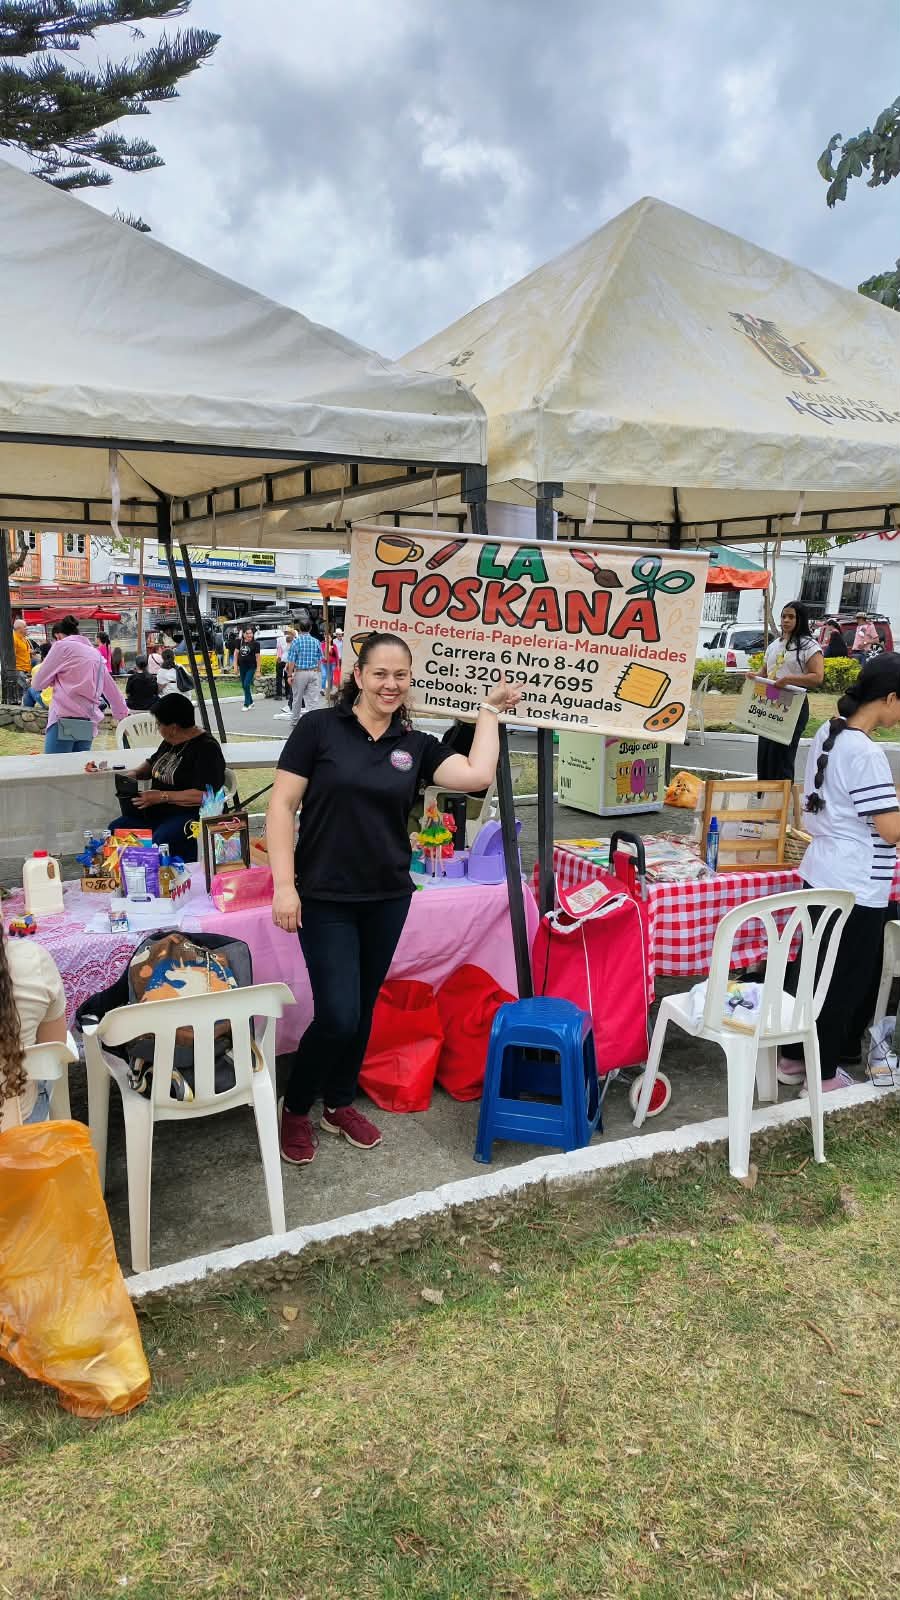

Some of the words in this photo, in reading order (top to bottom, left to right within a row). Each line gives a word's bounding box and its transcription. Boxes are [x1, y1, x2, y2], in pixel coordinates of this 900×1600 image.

[476, 541, 549, 584] LA
[371, 568, 661, 643] TOSKANA
[431, 642, 496, 663] Carrera
[500, 650, 512, 664] 6
[517, 652, 550, 668] Nro
[553, 656, 599, 674] 8-40
[425, 660, 459, 677] Cel:
[464, 665, 593, 693] 3205947695
[409, 678, 477, 695] acebook:
[481, 684, 547, 704] Tana
[550, 692, 623, 712] Aguadas
[748, 704, 767, 718] Bajo
[768, 713, 784, 722] cero
[619, 741, 641, 755] Bajo
